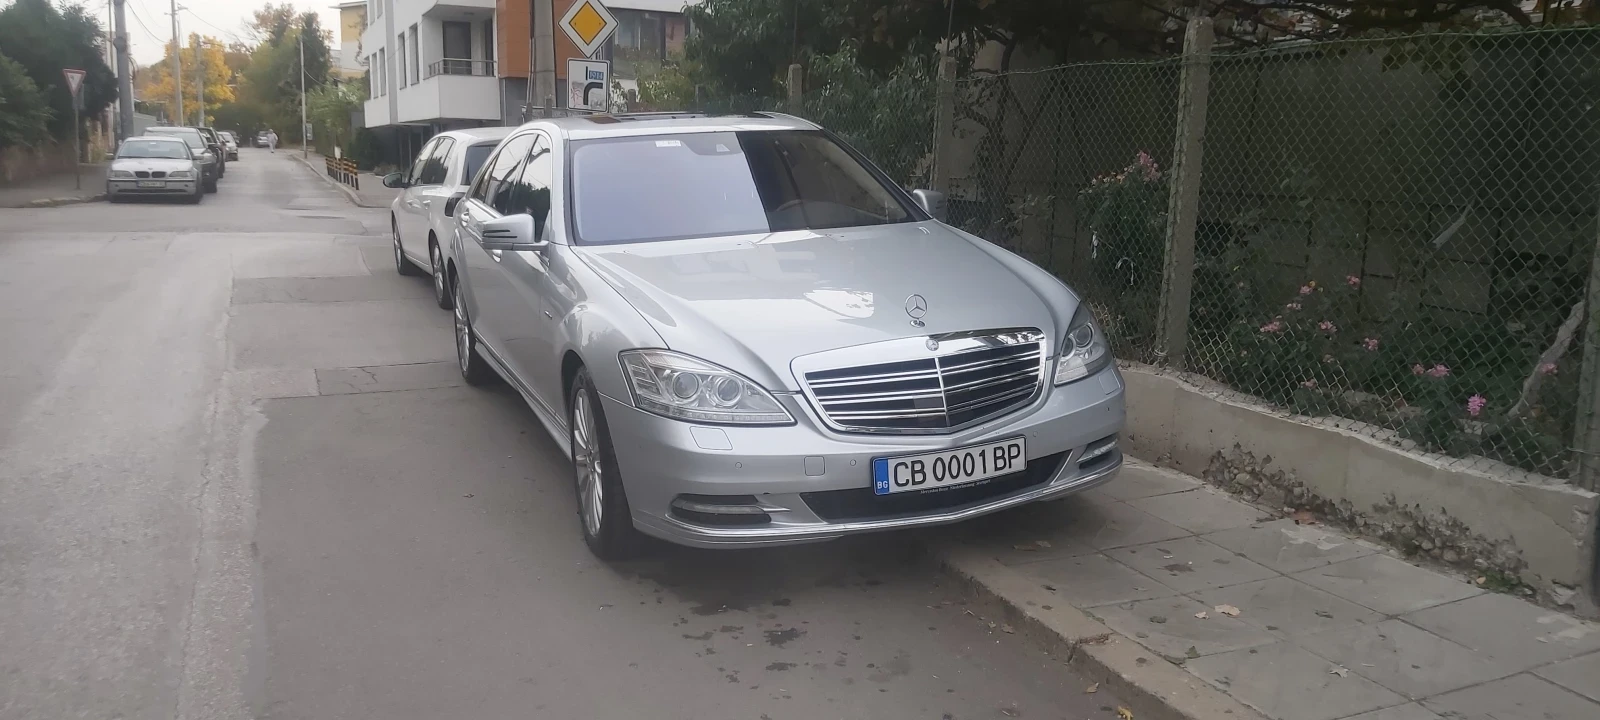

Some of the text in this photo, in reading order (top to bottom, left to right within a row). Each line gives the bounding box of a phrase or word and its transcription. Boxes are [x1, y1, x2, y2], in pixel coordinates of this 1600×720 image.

[893, 443, 1021, 488] CB 0001 BP
[877, 480, 888, 489] BG
